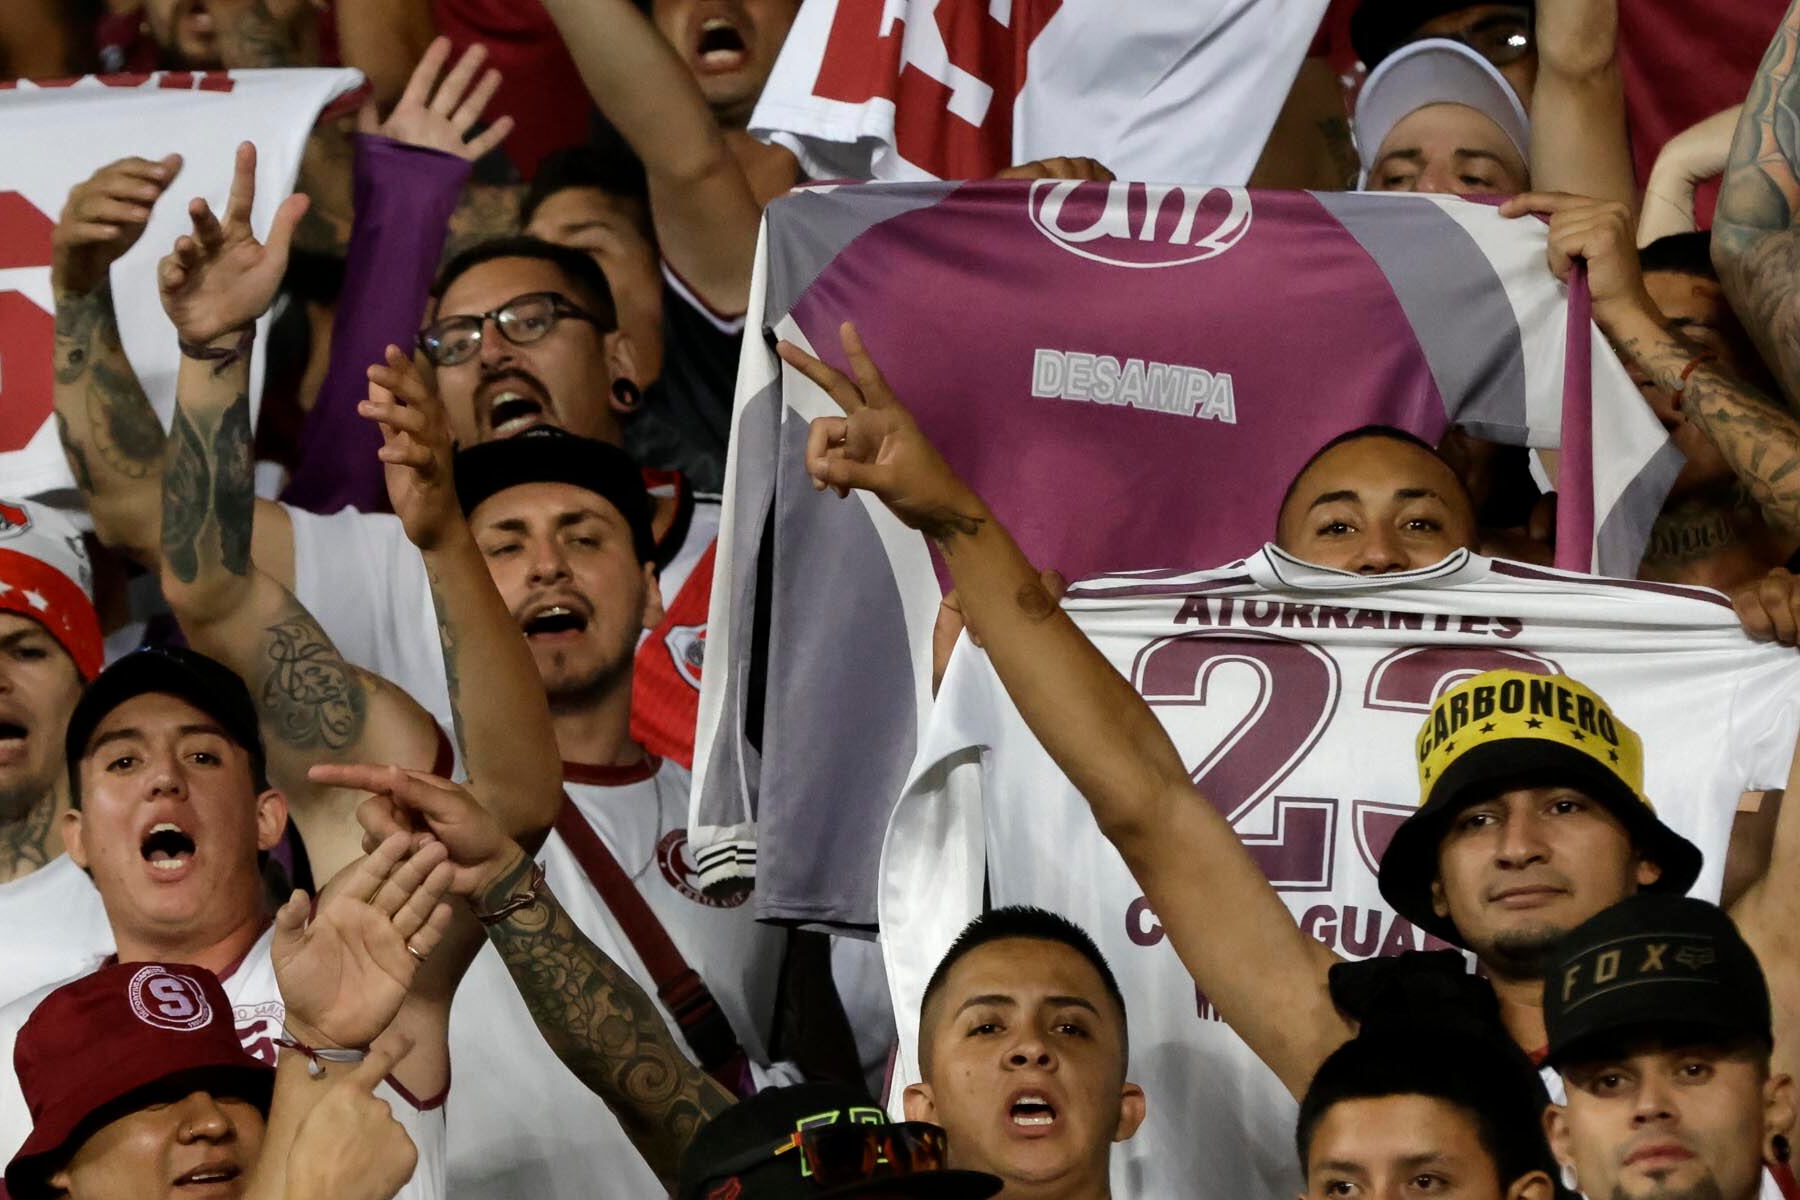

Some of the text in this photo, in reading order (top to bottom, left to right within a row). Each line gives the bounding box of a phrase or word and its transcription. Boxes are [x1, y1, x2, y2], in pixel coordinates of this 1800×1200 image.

[1032, 349, 1237, 424] DESAMPA
[1173, 596, 1523, 639] ATORRANTES
[1420, 678, 1619, 763] CARBONERO
[148, 978, 194, 1017] S
[1561, 943, 1670, 1001] FOX
